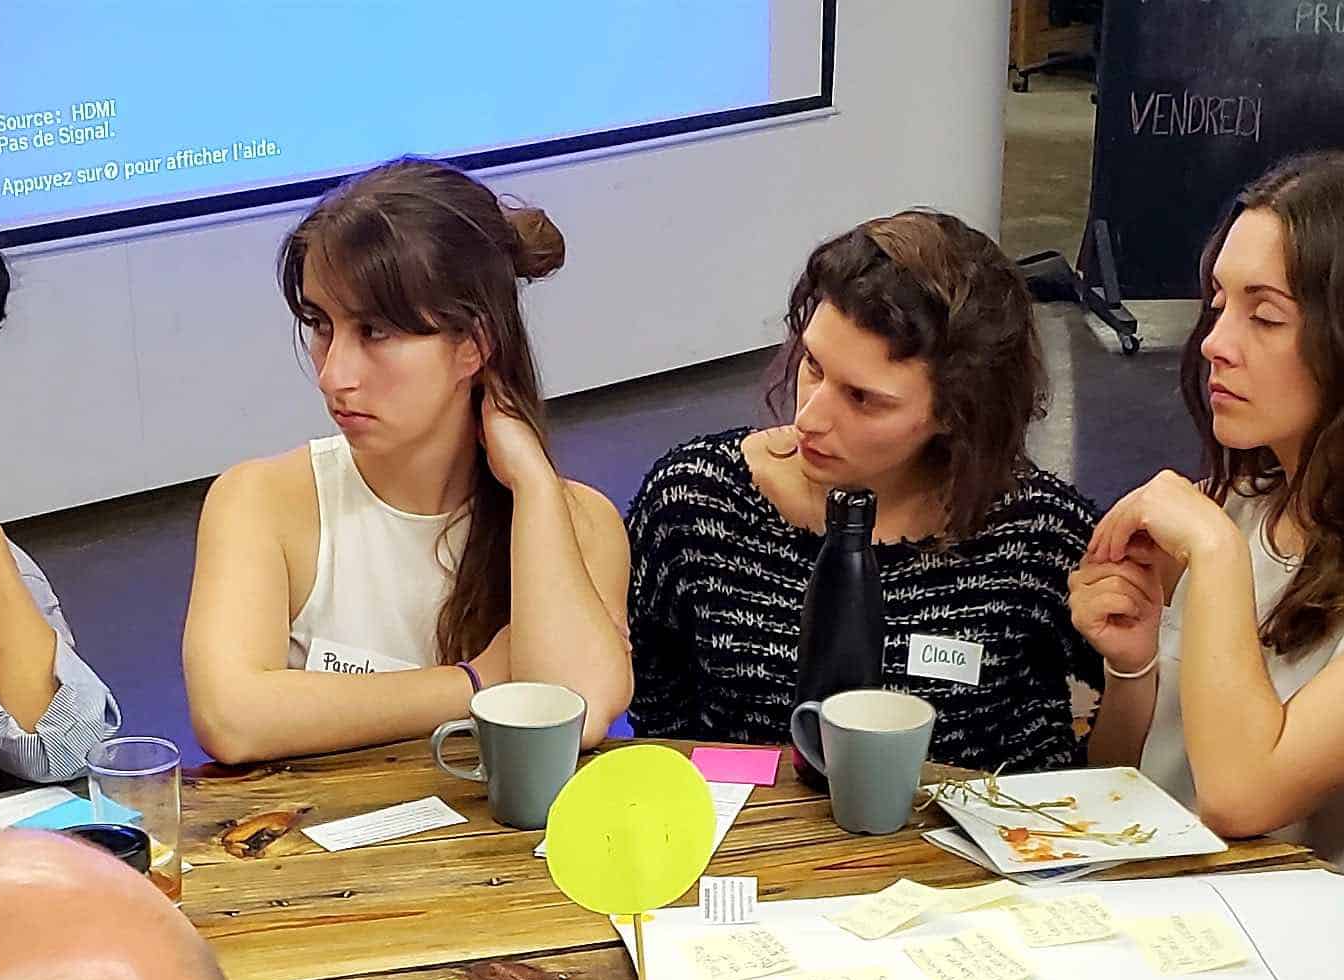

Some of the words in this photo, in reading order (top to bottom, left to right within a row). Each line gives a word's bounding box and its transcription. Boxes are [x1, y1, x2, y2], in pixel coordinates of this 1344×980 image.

[71, 98, 116, 121] HDMI
[33, 129, 55, 148] de
[58, 120, 116, 145] Signal.
[1, 170, 73, 196] Appuyez
[124, 158, 161, 180] pour
[166, 147, 228, 171] afficher
[232, 139, 282, 161] l'aide.
[921, 644, 967, 666] Clara
